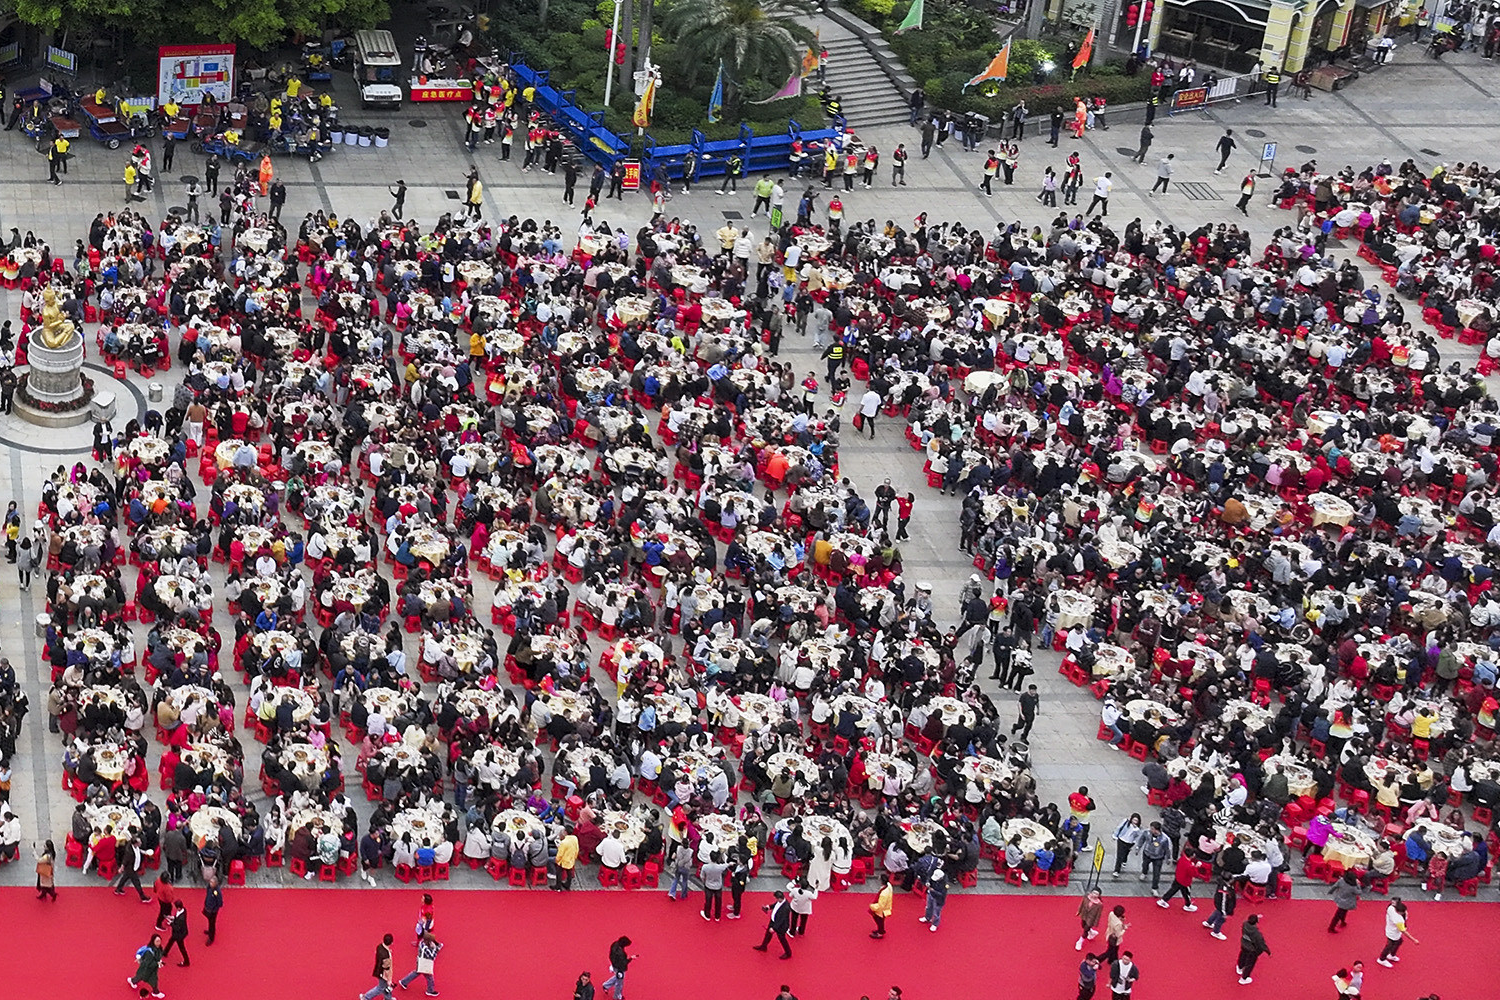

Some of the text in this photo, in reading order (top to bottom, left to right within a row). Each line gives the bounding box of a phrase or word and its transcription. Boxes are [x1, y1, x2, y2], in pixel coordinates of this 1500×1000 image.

[421, 90, 462, 99] 应急医疗点
